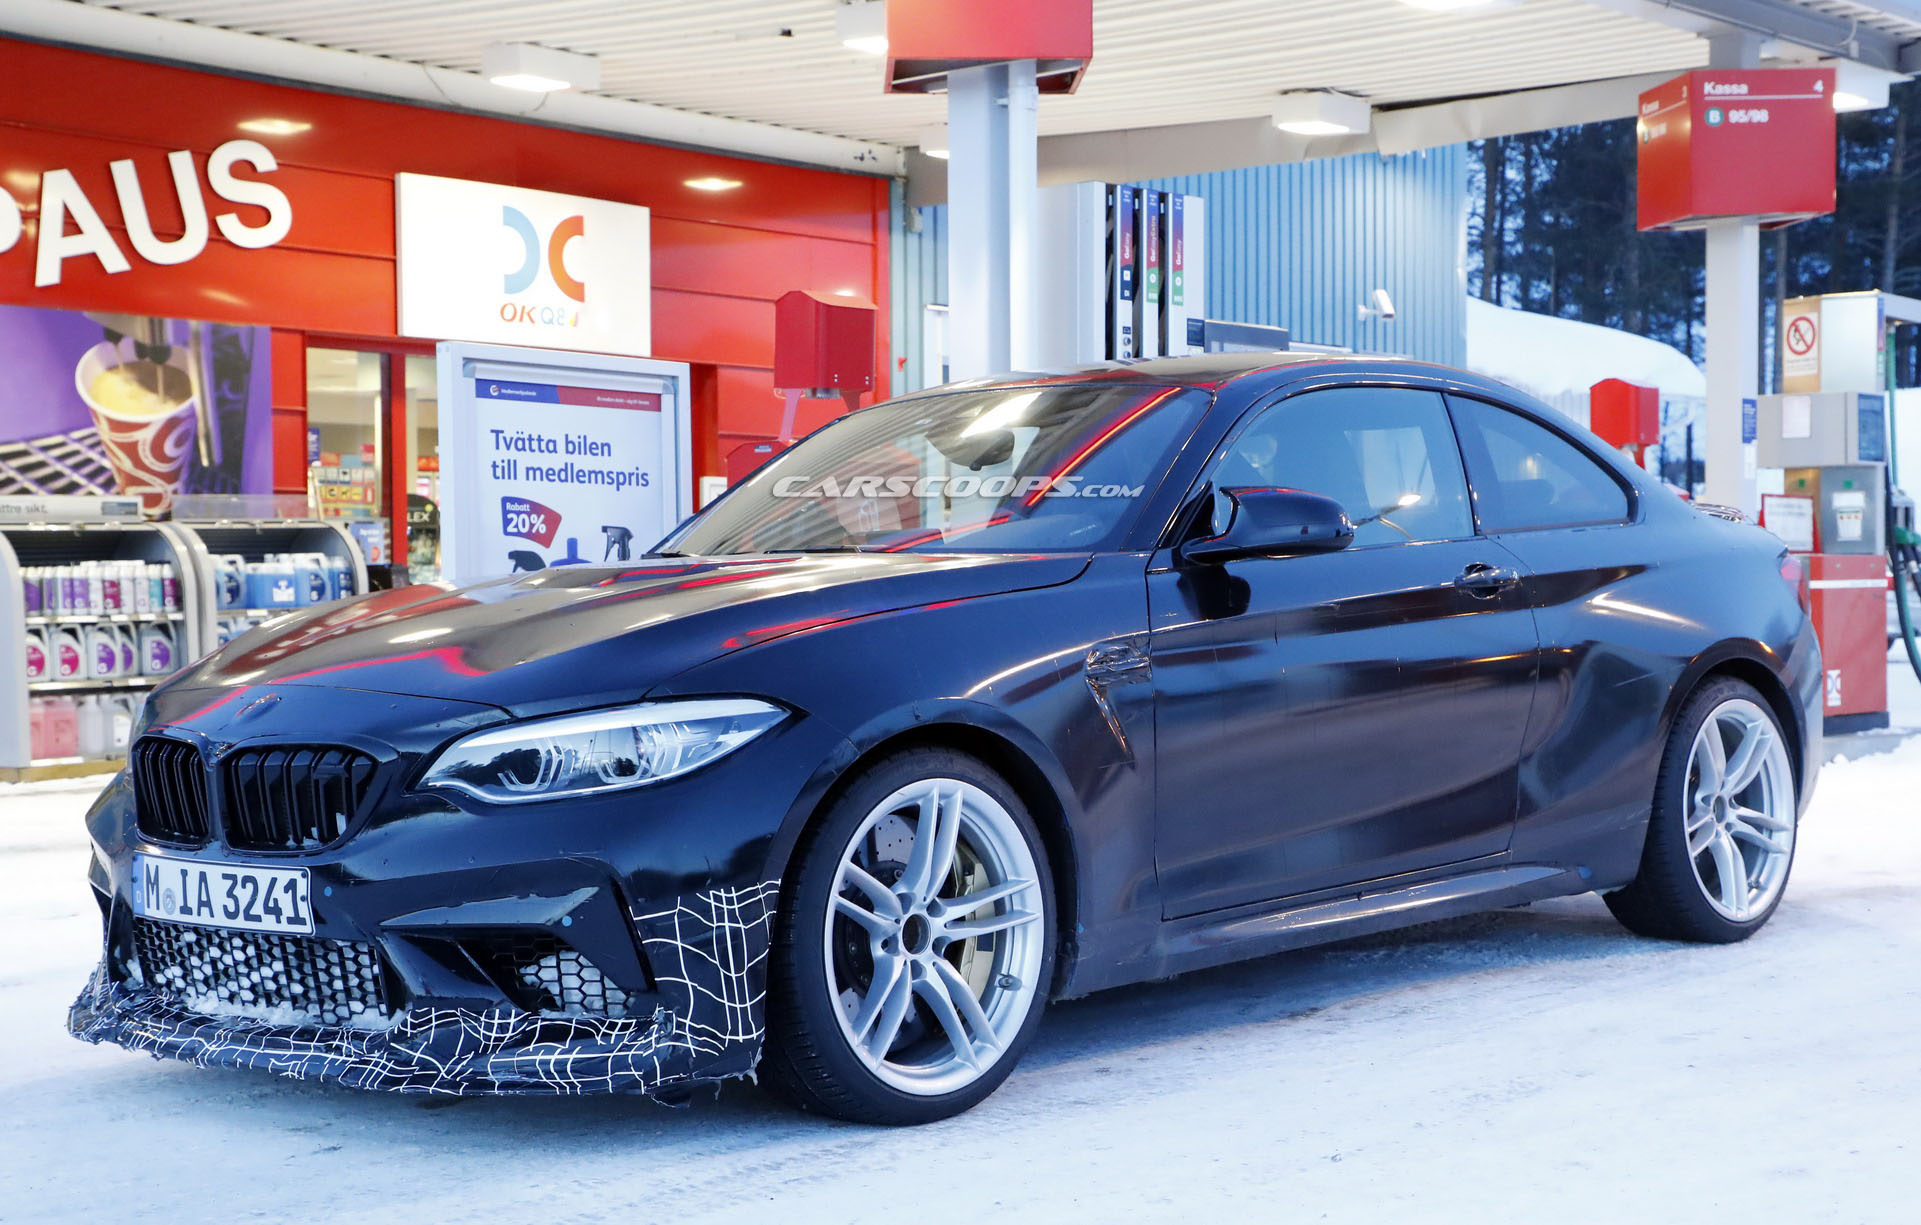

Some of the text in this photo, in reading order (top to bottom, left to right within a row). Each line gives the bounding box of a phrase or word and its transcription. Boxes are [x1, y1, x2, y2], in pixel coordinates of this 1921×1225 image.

[1703, 79, 1824, 94] Kassa 4
[1708, 109, 1721, 123] B
[490, 429, 611, 457] Tvätta bilen
[491, 459, 649, 492] till medlemspris
[506, 502, 530, 512] Rabatt
[506, 513, 547, 534] 20%
[145, 863, 308, 926] M IA 3241
